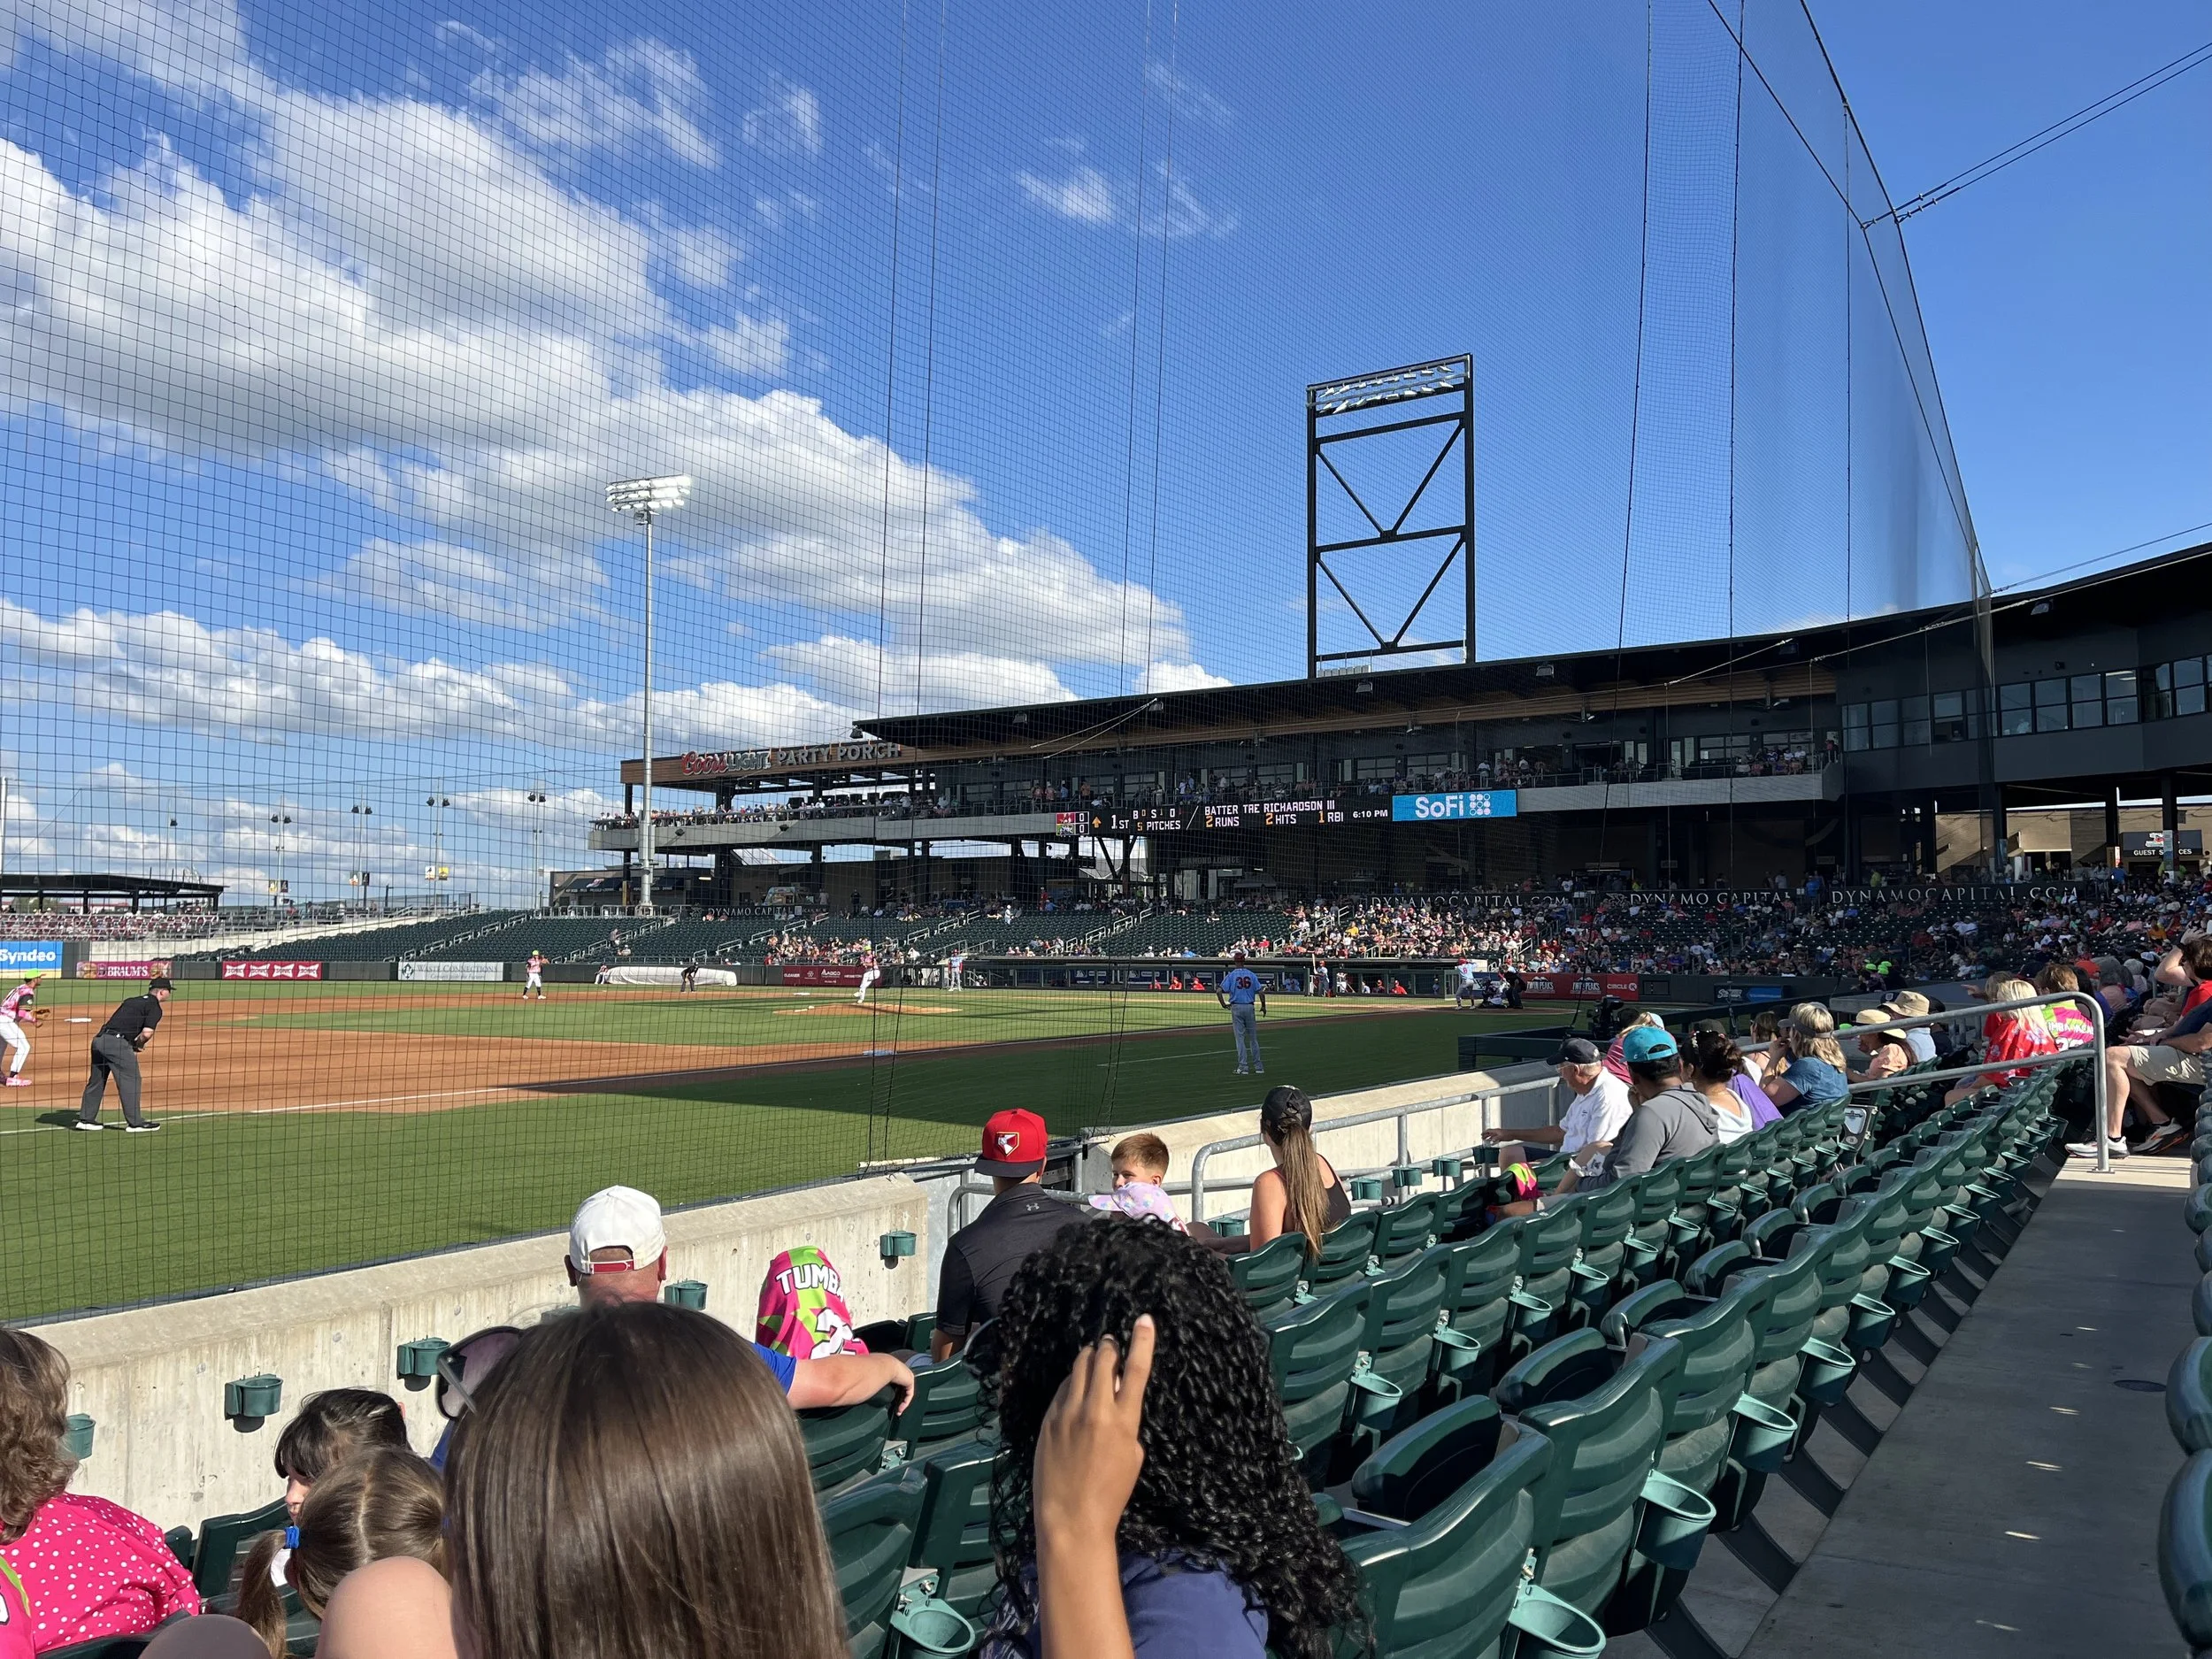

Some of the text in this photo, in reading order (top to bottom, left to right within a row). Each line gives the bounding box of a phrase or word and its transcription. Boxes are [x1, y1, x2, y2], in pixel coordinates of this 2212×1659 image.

[681, 742, 901, 775] Coors LIGHT PARTY PORCH
[1205, 804, 1239, 816] BATTER
[1263, 800, 1323, 813] RICHARDSON
[1415, 795, 1464, 818] SoFi
[1133, 810, 1139, 819] B
[1151, 809, 1157, 818] S
[1265, 810, 1344, 826] 2 HITS 1 RBI
[1146, 819, 1181, 831] PITCHES
[1205, 816, 1240, 827] 2 RUNS
[1630, 892, 1709, 905] DYNAMO
[708, 907, 751, 916] DYNAMO
[0, 948, 56, 964] Syndeo
[107, 966, 149, 977] BRAUM'S
[1540, 981, 1555, 990] PEAKS
